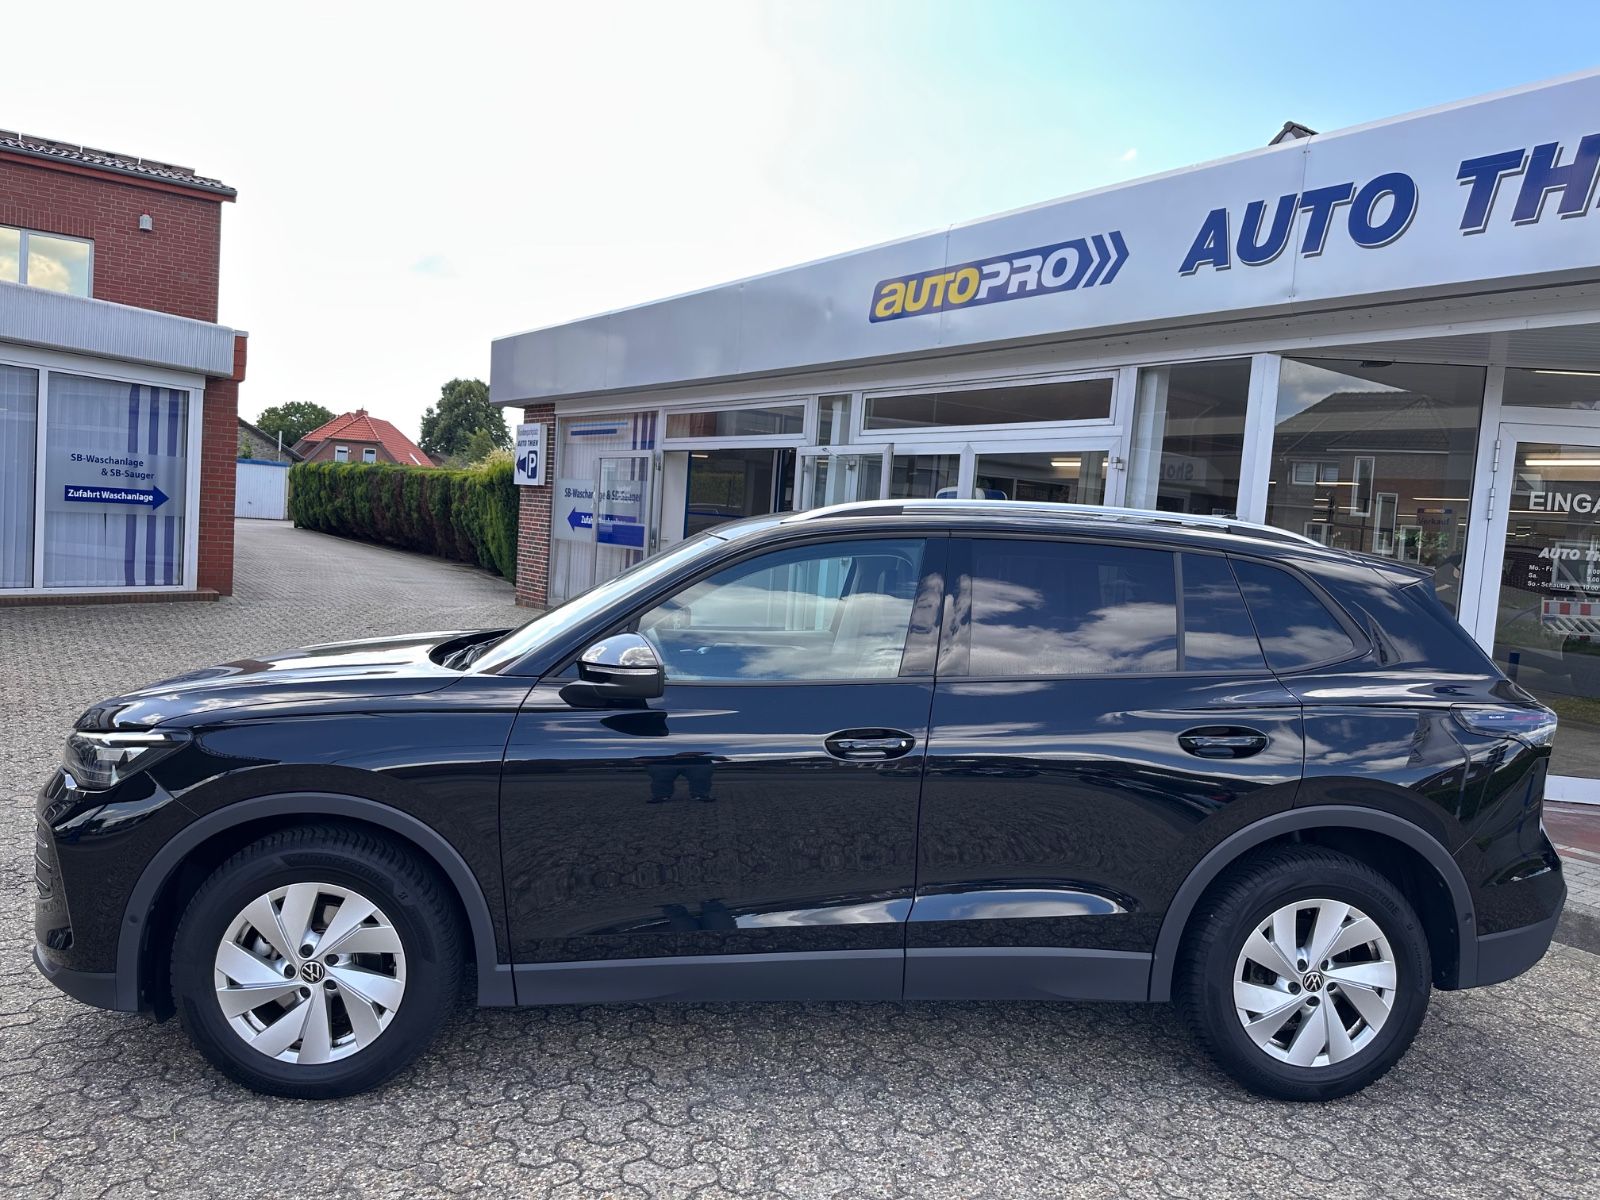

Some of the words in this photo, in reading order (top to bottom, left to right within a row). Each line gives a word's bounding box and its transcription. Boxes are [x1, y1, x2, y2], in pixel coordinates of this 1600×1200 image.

[1178, 172, 1419, 277] AUTO
[1456, 133, 1600, 236] TH
[71, 453, 144, 468] SB-Waschanlage
[101, 468, 108, 476] &
[110, 468, 155, 481] SB-Sauger
[68, 489, 100, 499] Zufahrt
[101, 490, 153, 502] Waschanlage
[1538, 547, 1580, 560] AUTO
